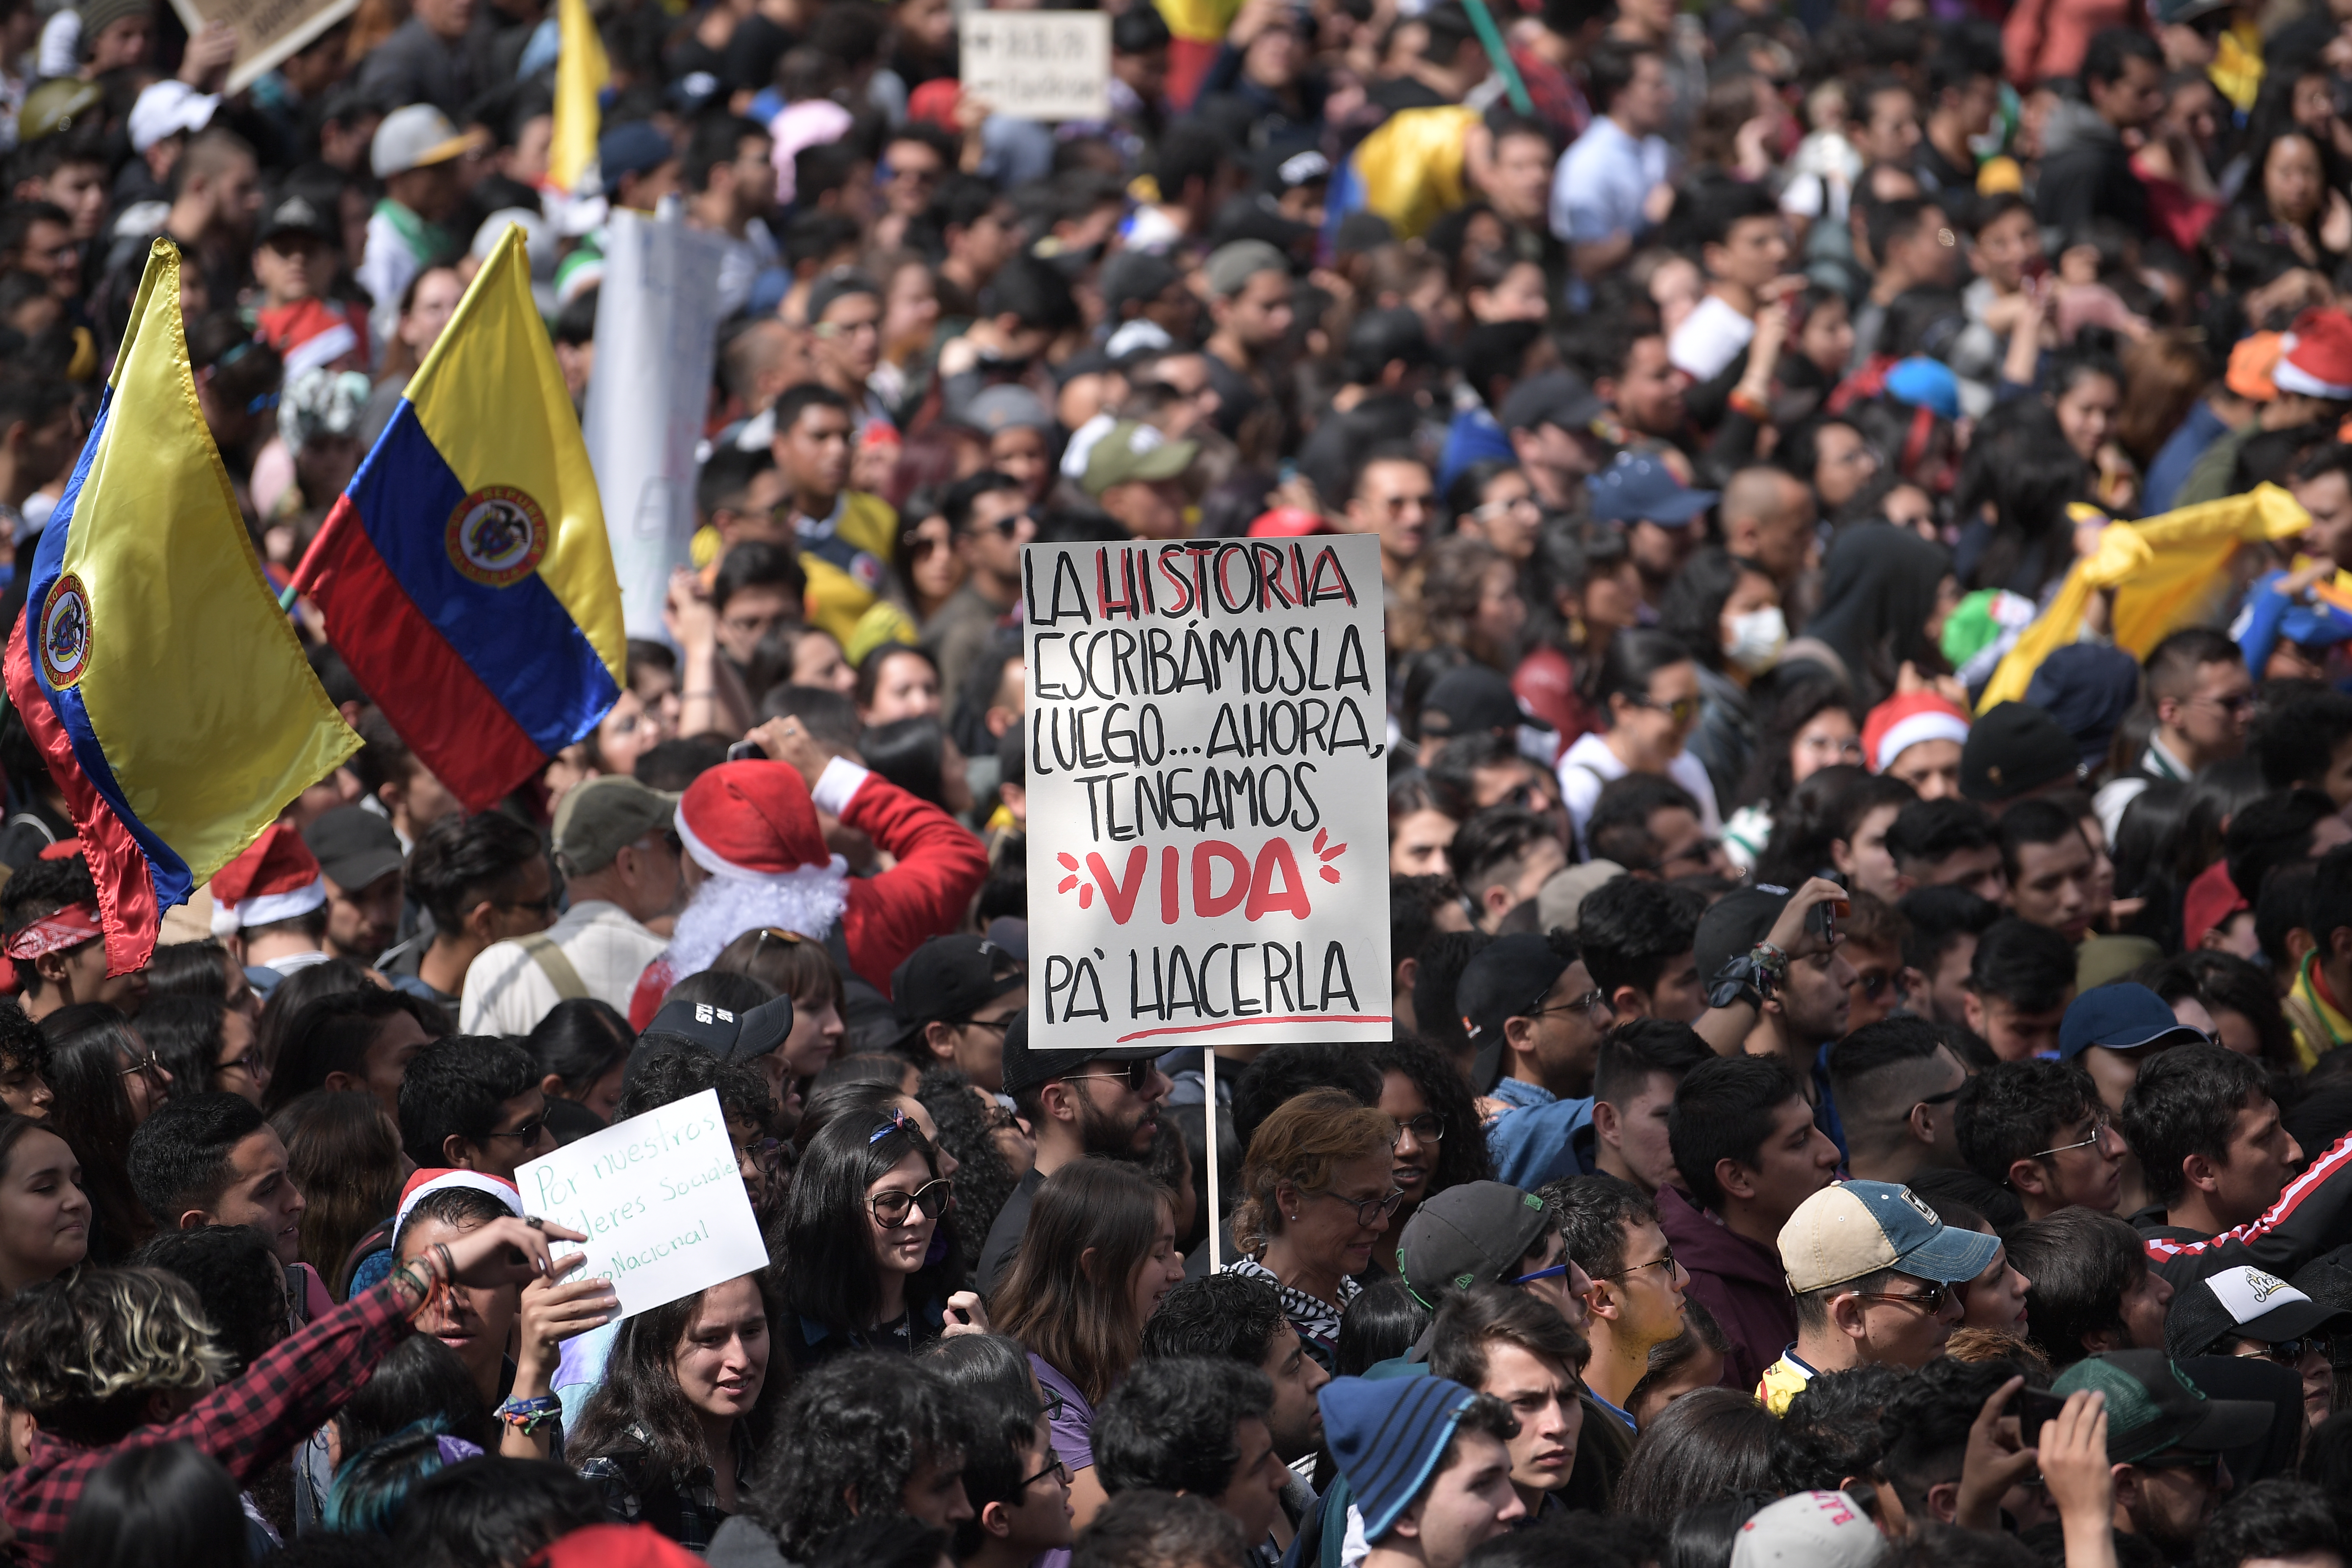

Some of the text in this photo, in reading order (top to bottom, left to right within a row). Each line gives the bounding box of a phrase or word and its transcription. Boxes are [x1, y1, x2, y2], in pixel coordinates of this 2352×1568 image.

[1025, 541, 1358, 627] LA HISTORIA
[41, 577, 91, 684] REPUBLICA DE COLOMBIA
[1034, 619, 1372, 700] ESCRIBÁMOSLA
[1074, 762, 1320, 842] TENGAMOS
[1086, 837, 1311, 925] VIDA
[1131, 941, 1360, 1021] HACERLA
[535, 1113, 715, 1211] Por nuestros
